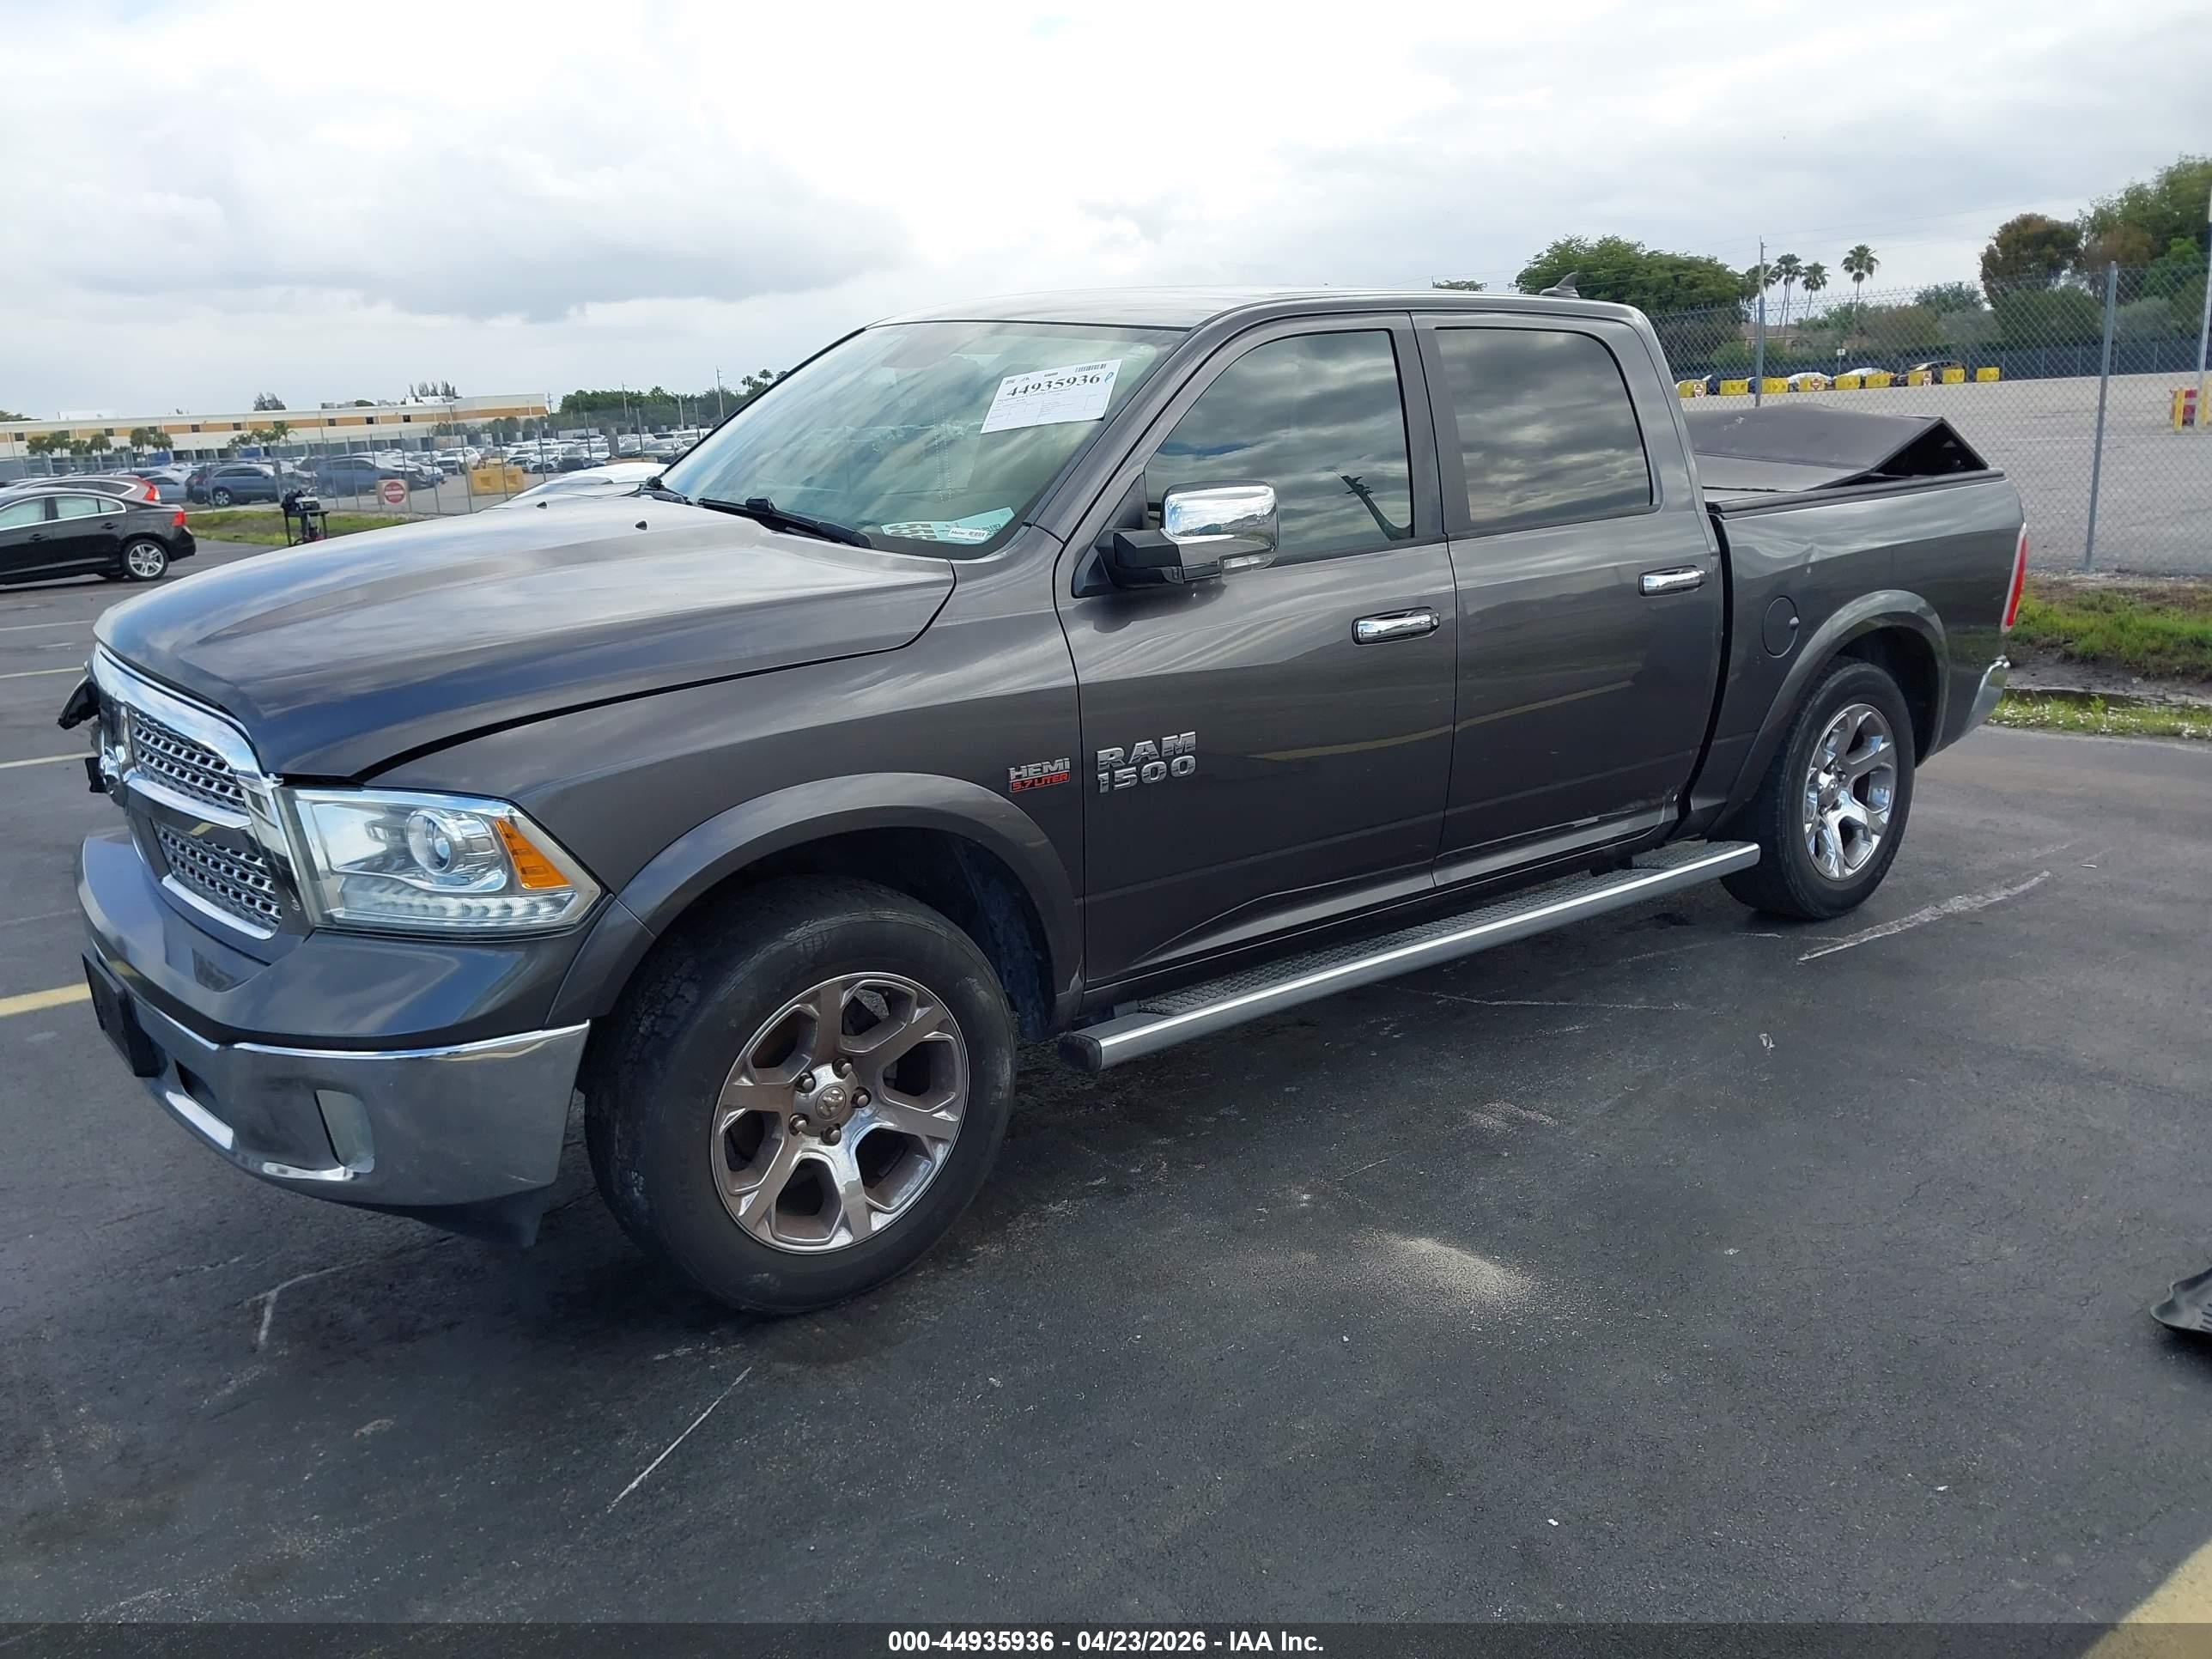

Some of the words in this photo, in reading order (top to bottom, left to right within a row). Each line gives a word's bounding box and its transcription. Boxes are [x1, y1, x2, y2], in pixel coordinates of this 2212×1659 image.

[1006, 373, 1100, 397] 44935936
[1096, 731, 1196, 769] RAM
[1009, 757, 1071, 781] HEMI
[1097, 755, 1196, 793] 1500
[1012, 777, 1034, 790] 5.7
[1035, 773, 1069, 787] LITER
